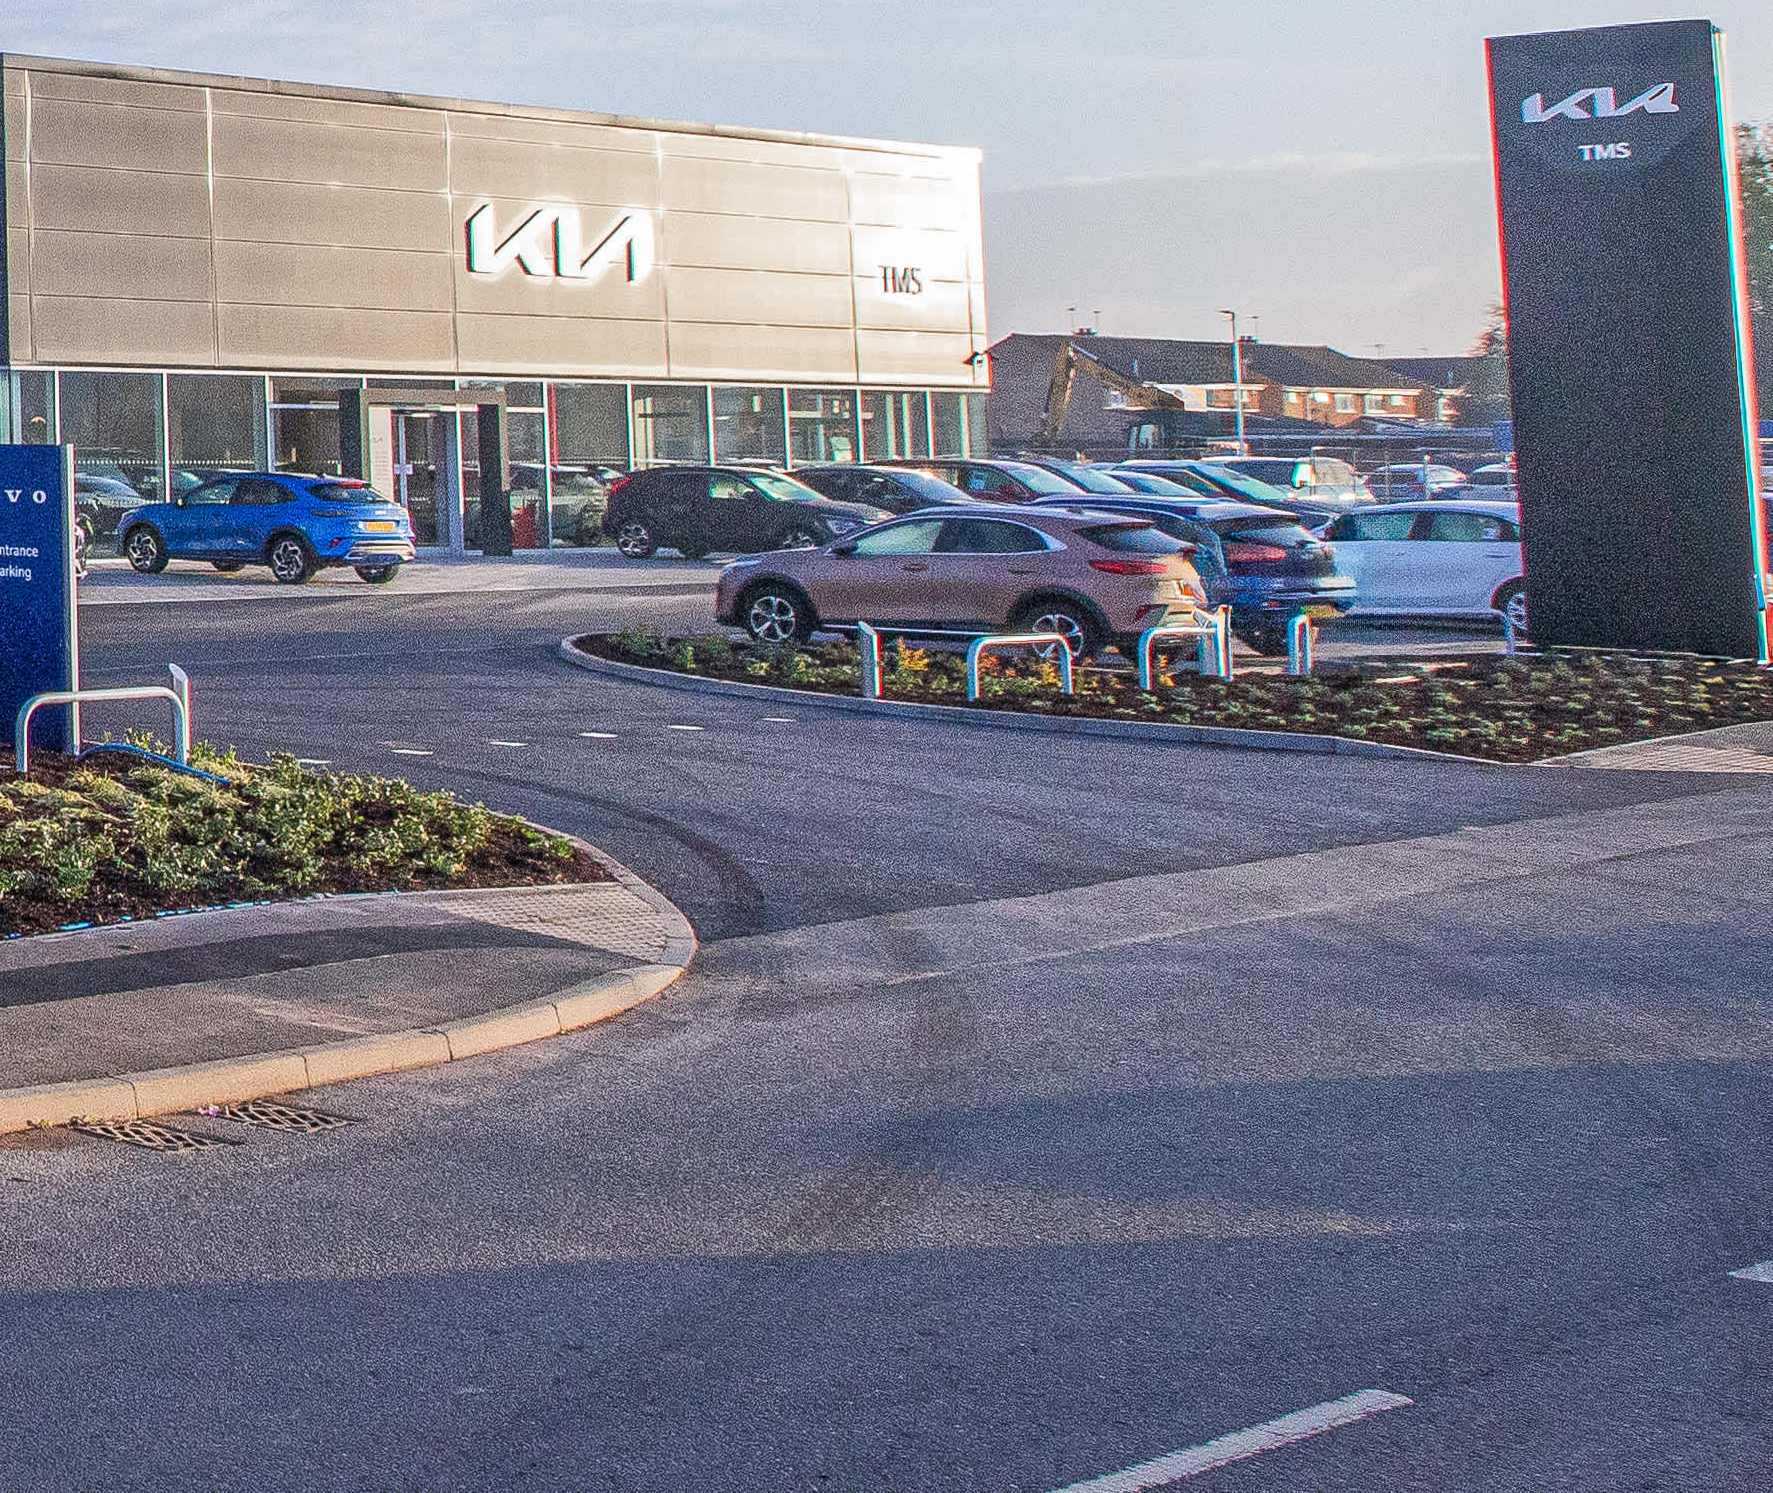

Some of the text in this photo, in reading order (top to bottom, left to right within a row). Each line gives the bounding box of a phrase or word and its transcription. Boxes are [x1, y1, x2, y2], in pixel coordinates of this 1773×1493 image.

[1521, 83, 1679, 123] KIA
[1578, 142, 1632, 161] TMS
[464, 202, 653, 284] KIA
[877, 265, 923, 295] TMS
